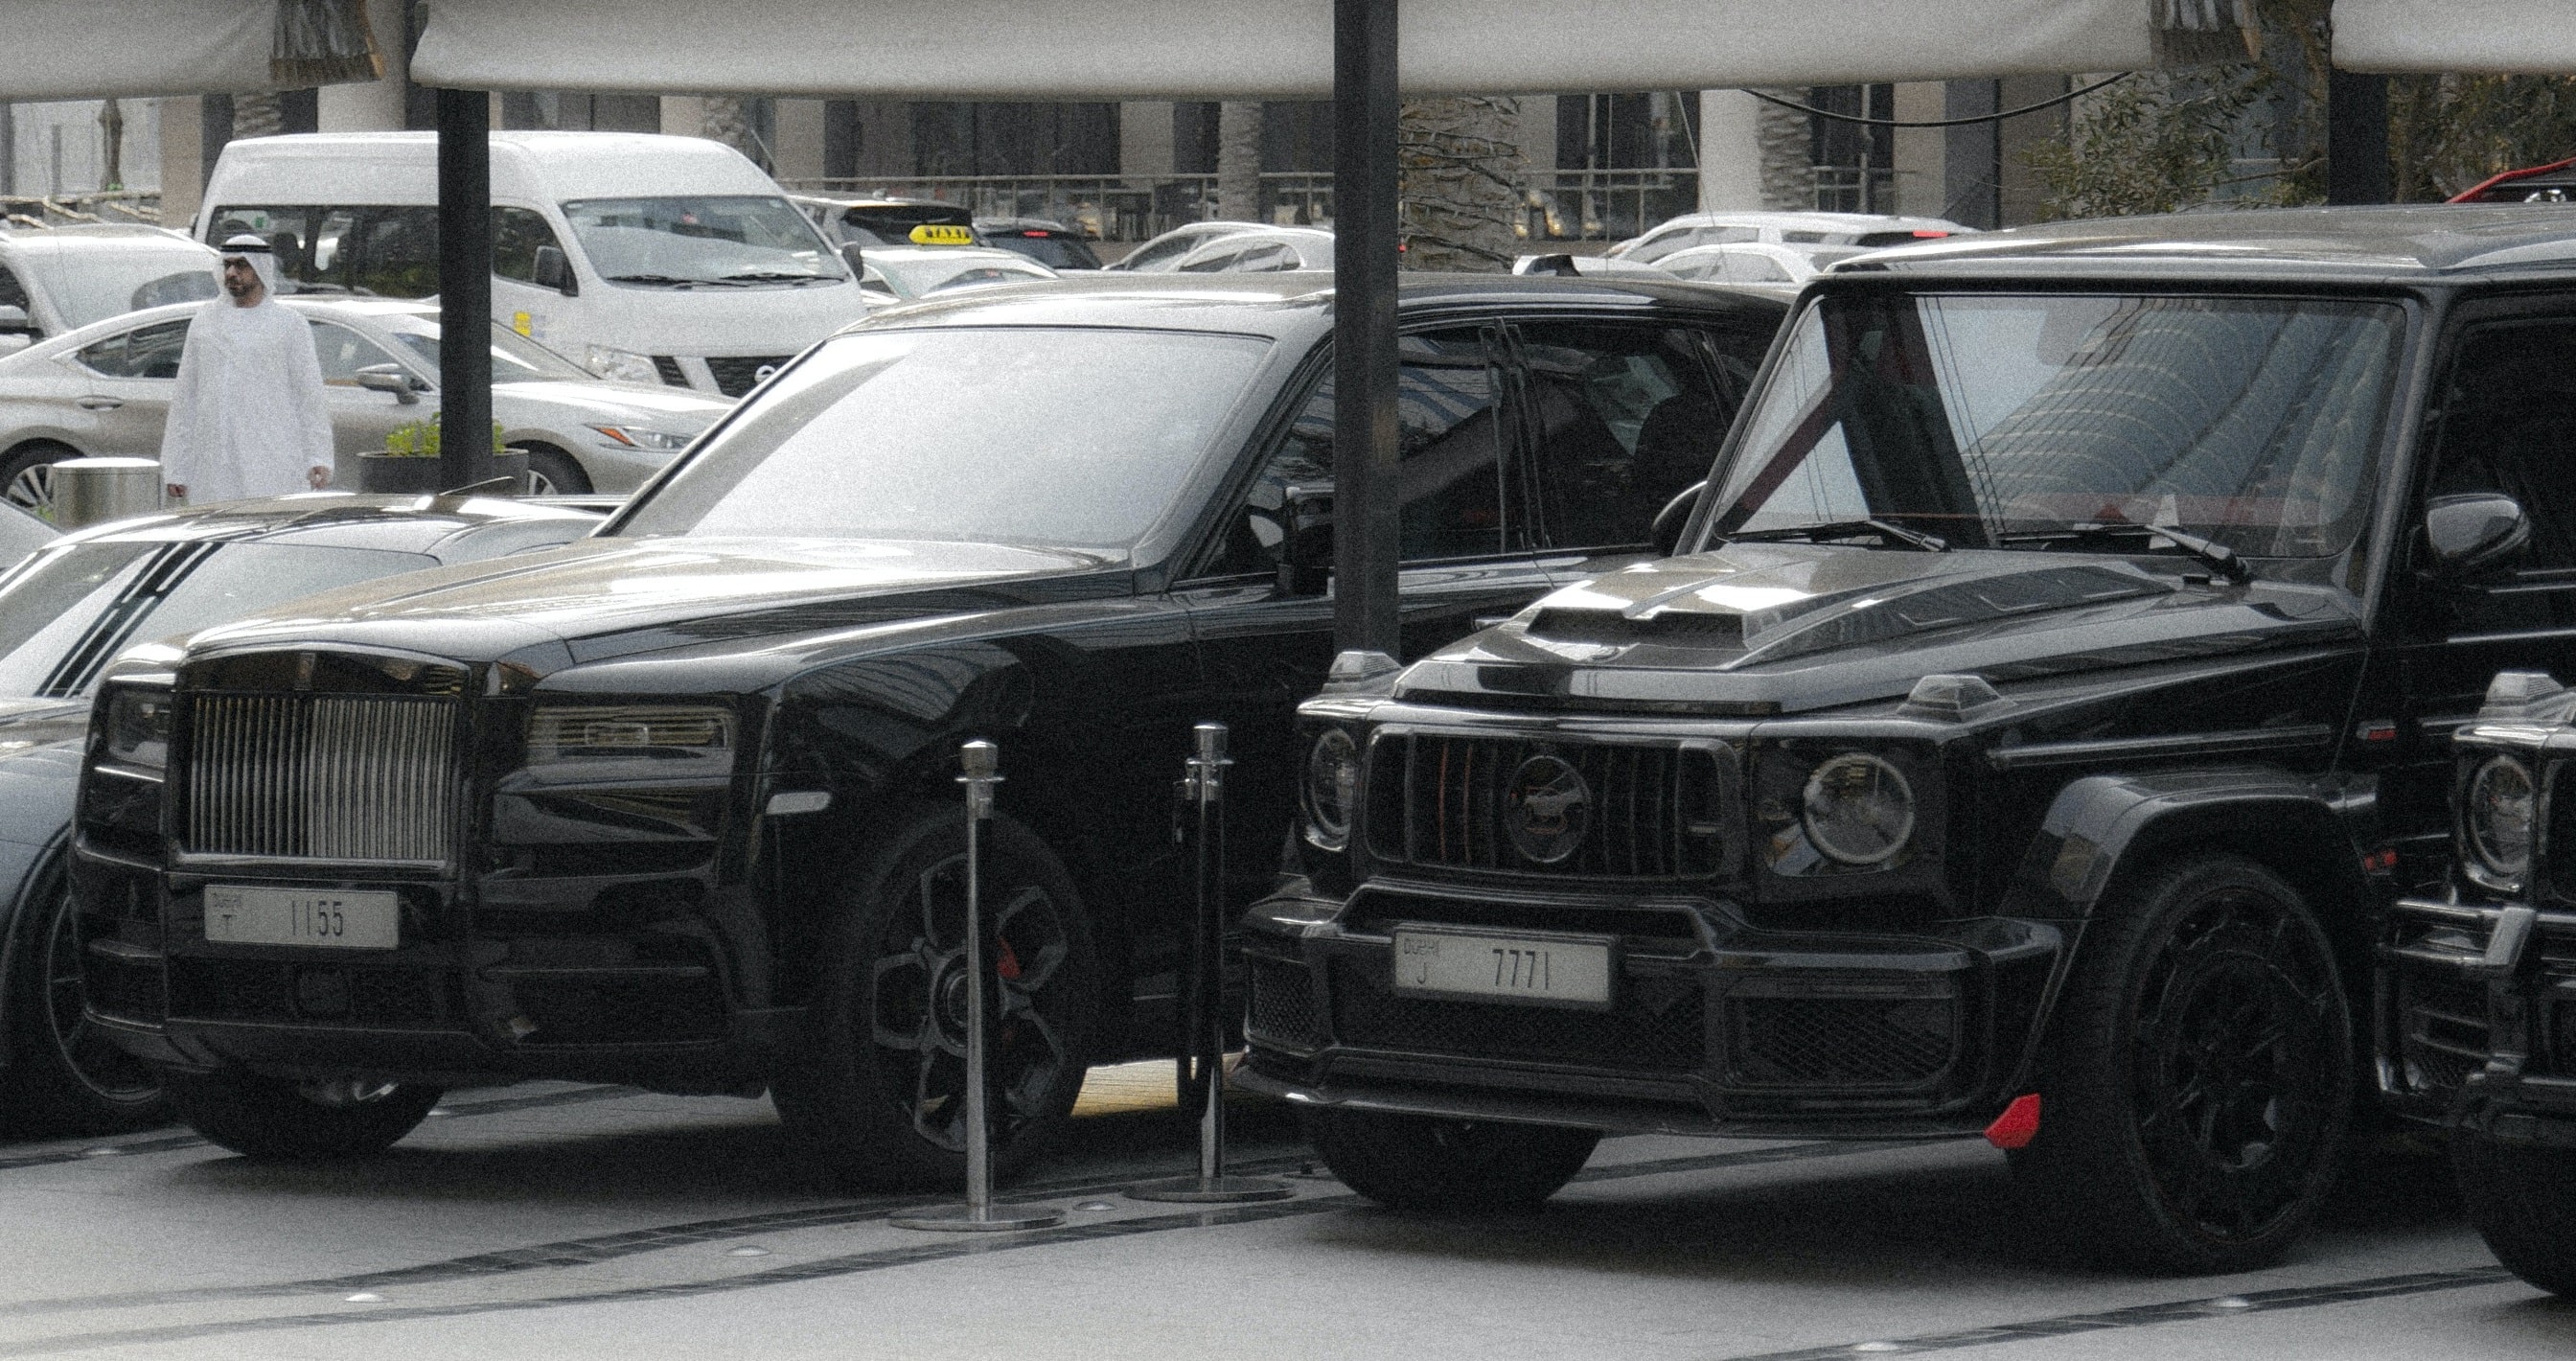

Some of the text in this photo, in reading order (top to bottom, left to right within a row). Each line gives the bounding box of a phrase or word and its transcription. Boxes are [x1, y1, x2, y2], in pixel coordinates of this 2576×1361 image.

[291, 900, 344, 936] 1155
[1416, 948, 1550, 990] J 7771
